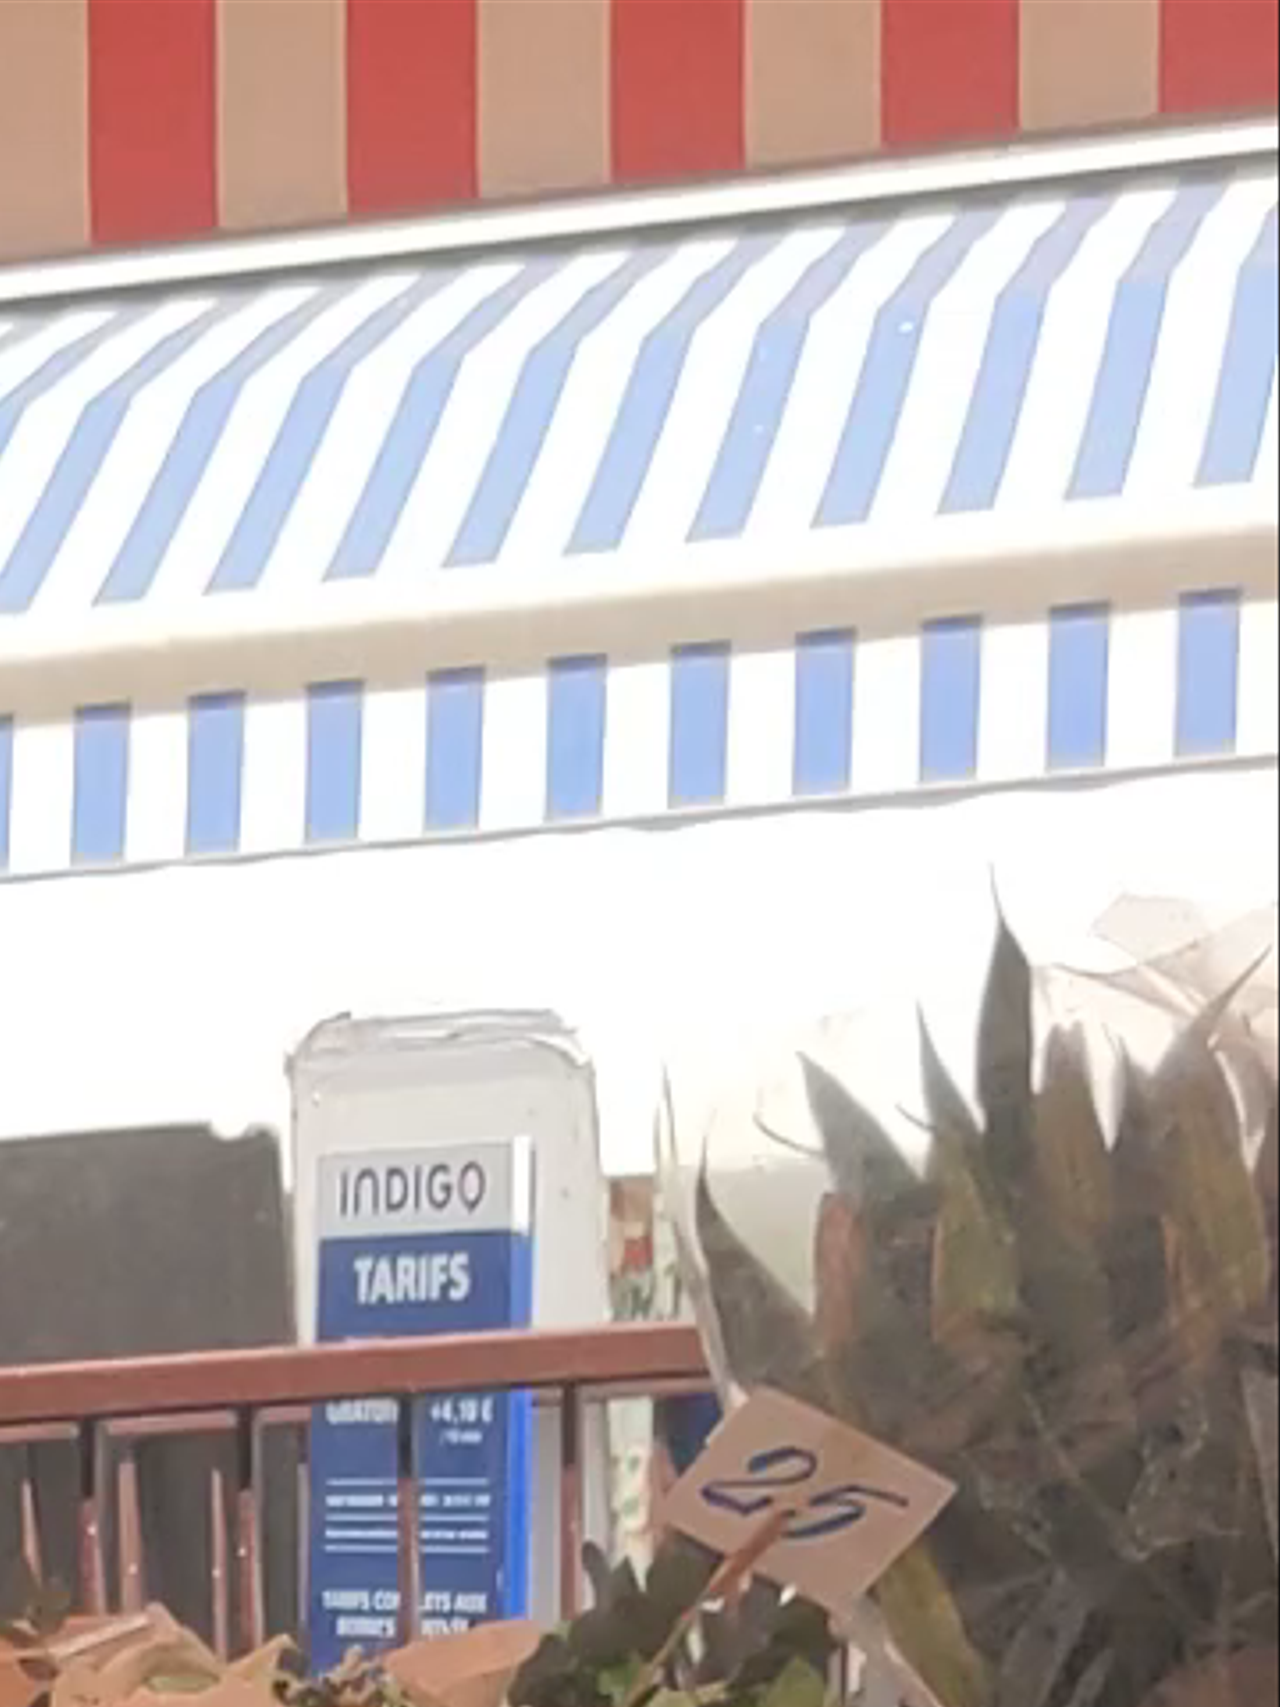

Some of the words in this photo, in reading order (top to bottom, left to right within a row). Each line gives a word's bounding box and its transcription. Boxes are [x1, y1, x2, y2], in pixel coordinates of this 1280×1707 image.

[340, 1161, 486, 1216] INDIGO
[354, 1252, 469, 1305] TARIFS
[700, 1446, 909, 1538] 25
